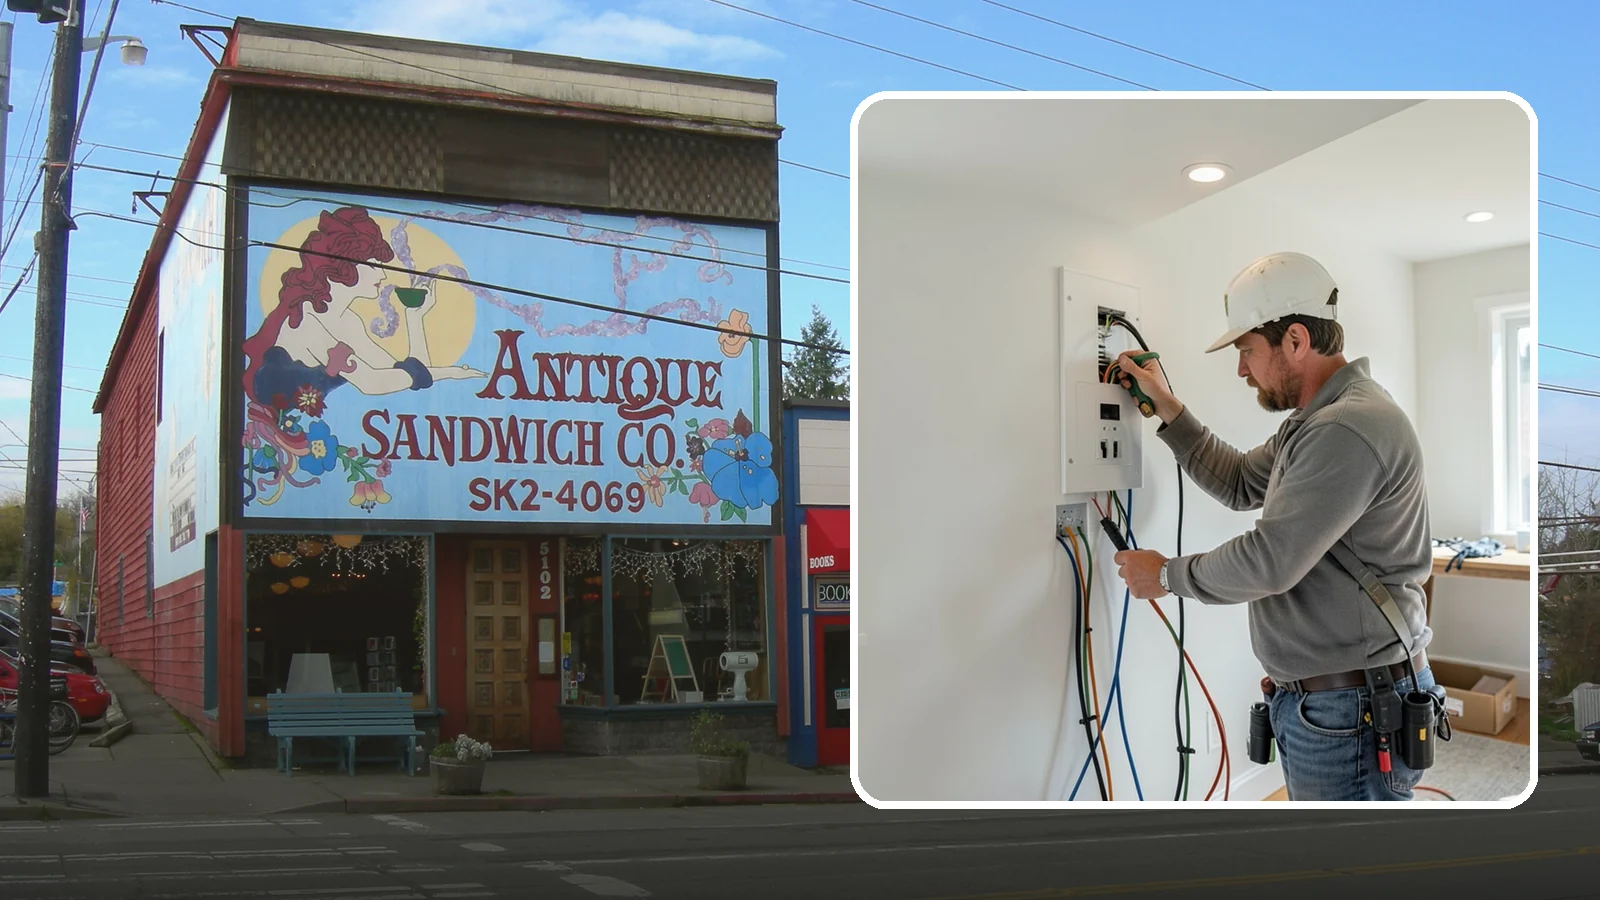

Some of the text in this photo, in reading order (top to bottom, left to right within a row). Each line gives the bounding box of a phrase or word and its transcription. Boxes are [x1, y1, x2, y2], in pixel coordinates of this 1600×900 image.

[475, 328, 724, 422] ANTIQUE
[361, 408, 685, 469] SANDWICH CO.
[468, 476, 646, 513] SK2-4069
[540, 541, 551, 600] 5102
[809, 555, 835, 569] BOOKS
